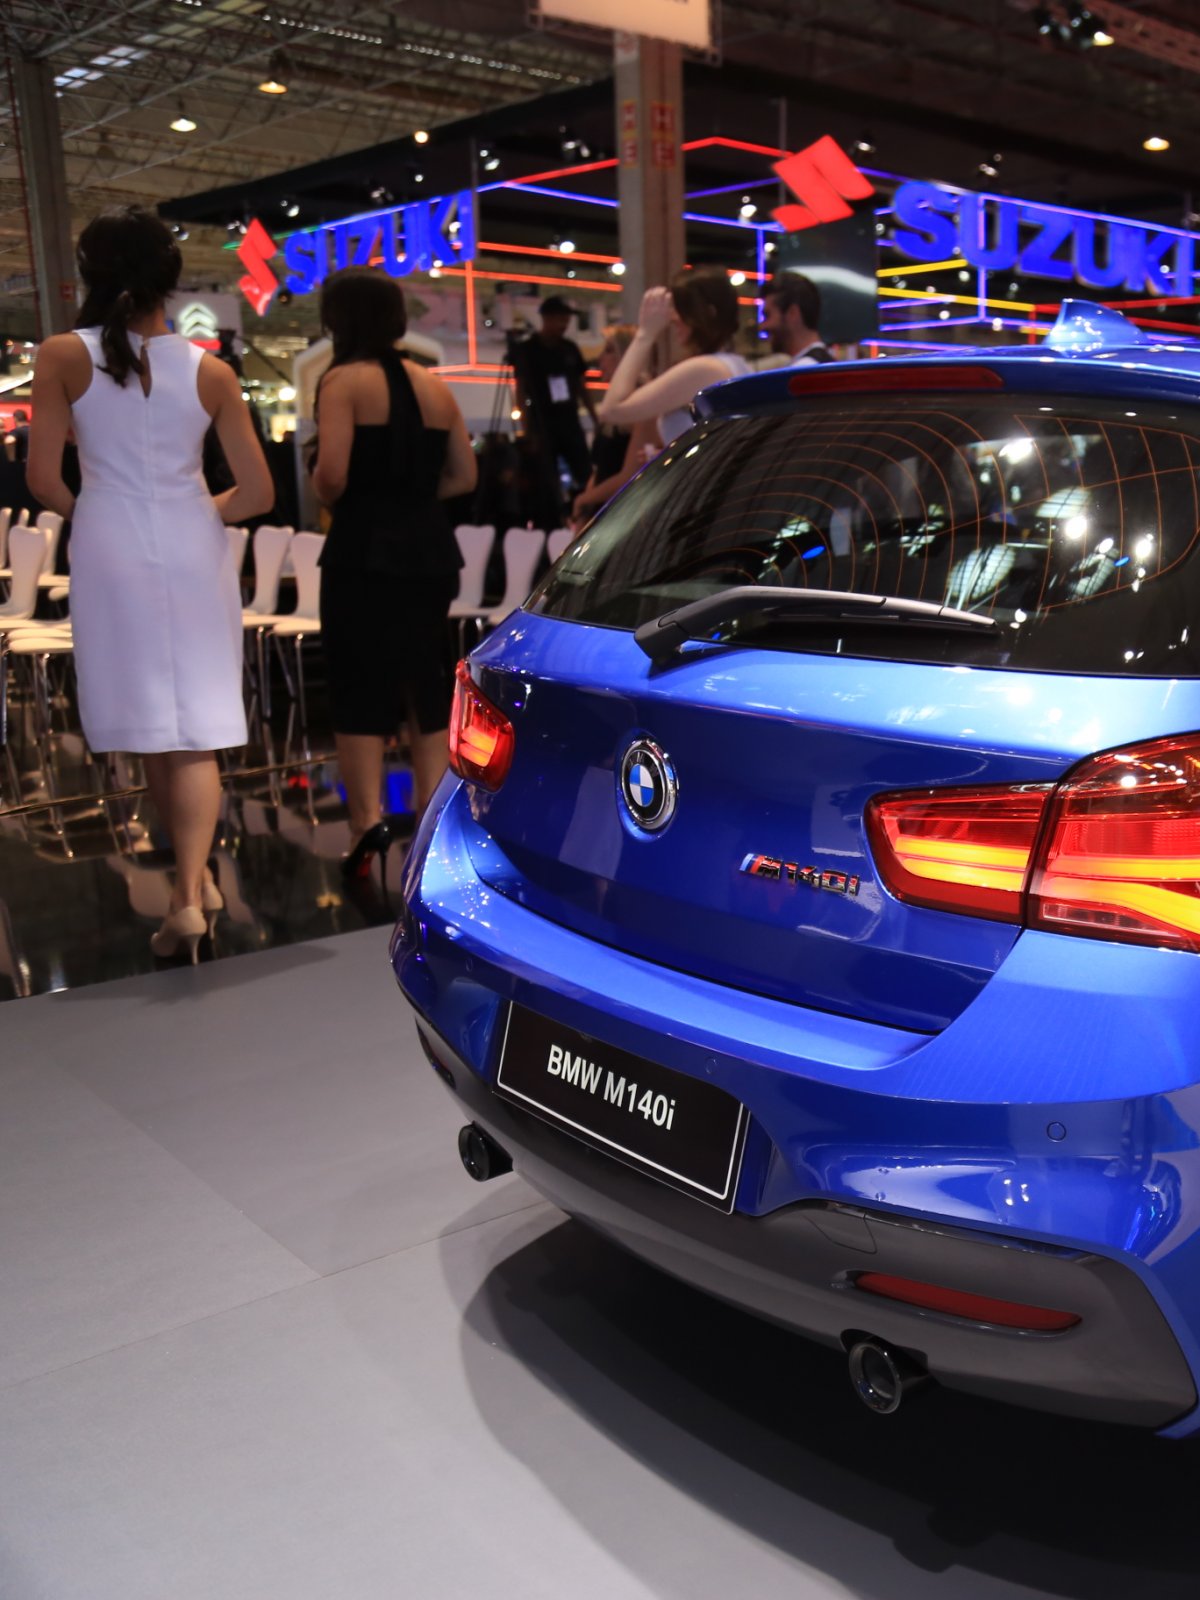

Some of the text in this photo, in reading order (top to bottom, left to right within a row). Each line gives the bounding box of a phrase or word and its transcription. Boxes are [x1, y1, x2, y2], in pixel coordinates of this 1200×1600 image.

[284, 190, 476, 294] SUZUKI
[893, 180, 1194, 298] SUZUKI
[547, 1044, 677, 1131] BMW M140i
